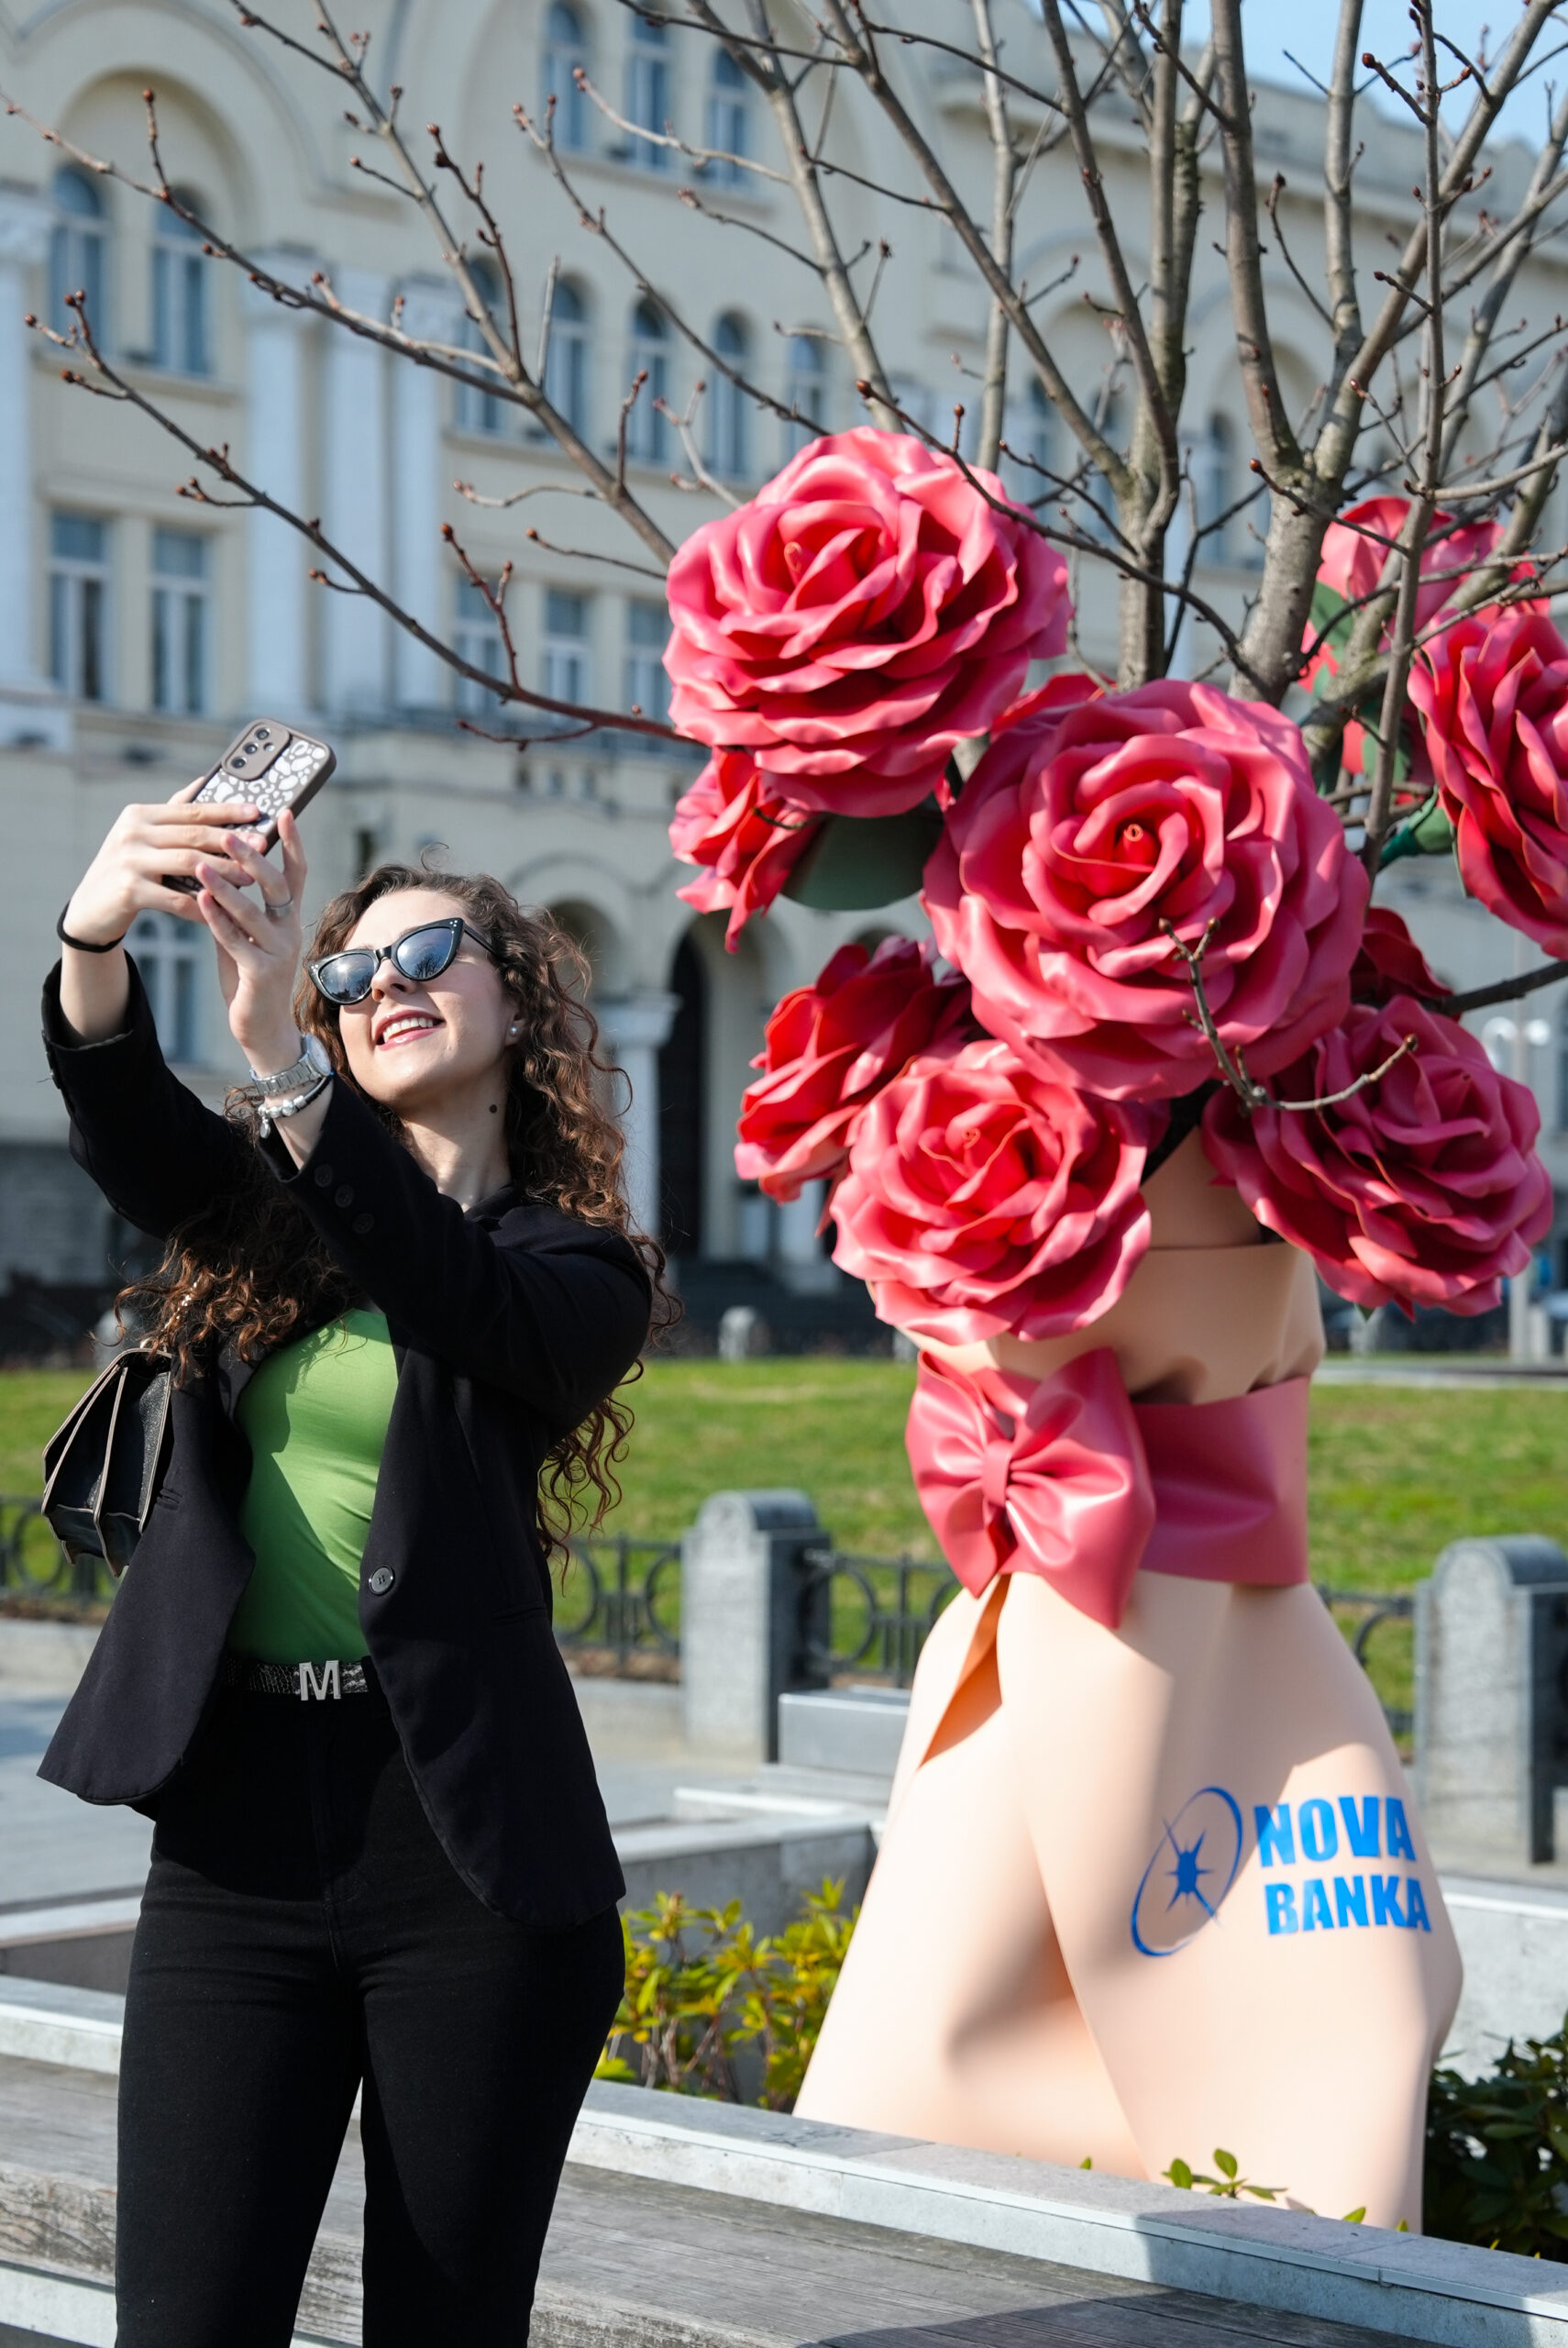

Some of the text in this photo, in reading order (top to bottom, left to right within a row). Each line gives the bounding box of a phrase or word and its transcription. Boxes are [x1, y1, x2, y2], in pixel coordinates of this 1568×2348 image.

[299, 1660, 341, 1700] M
[1253, 1796, 1417, 1867] NOVA
[1264, 1874, 1431, 1935] BANKA
